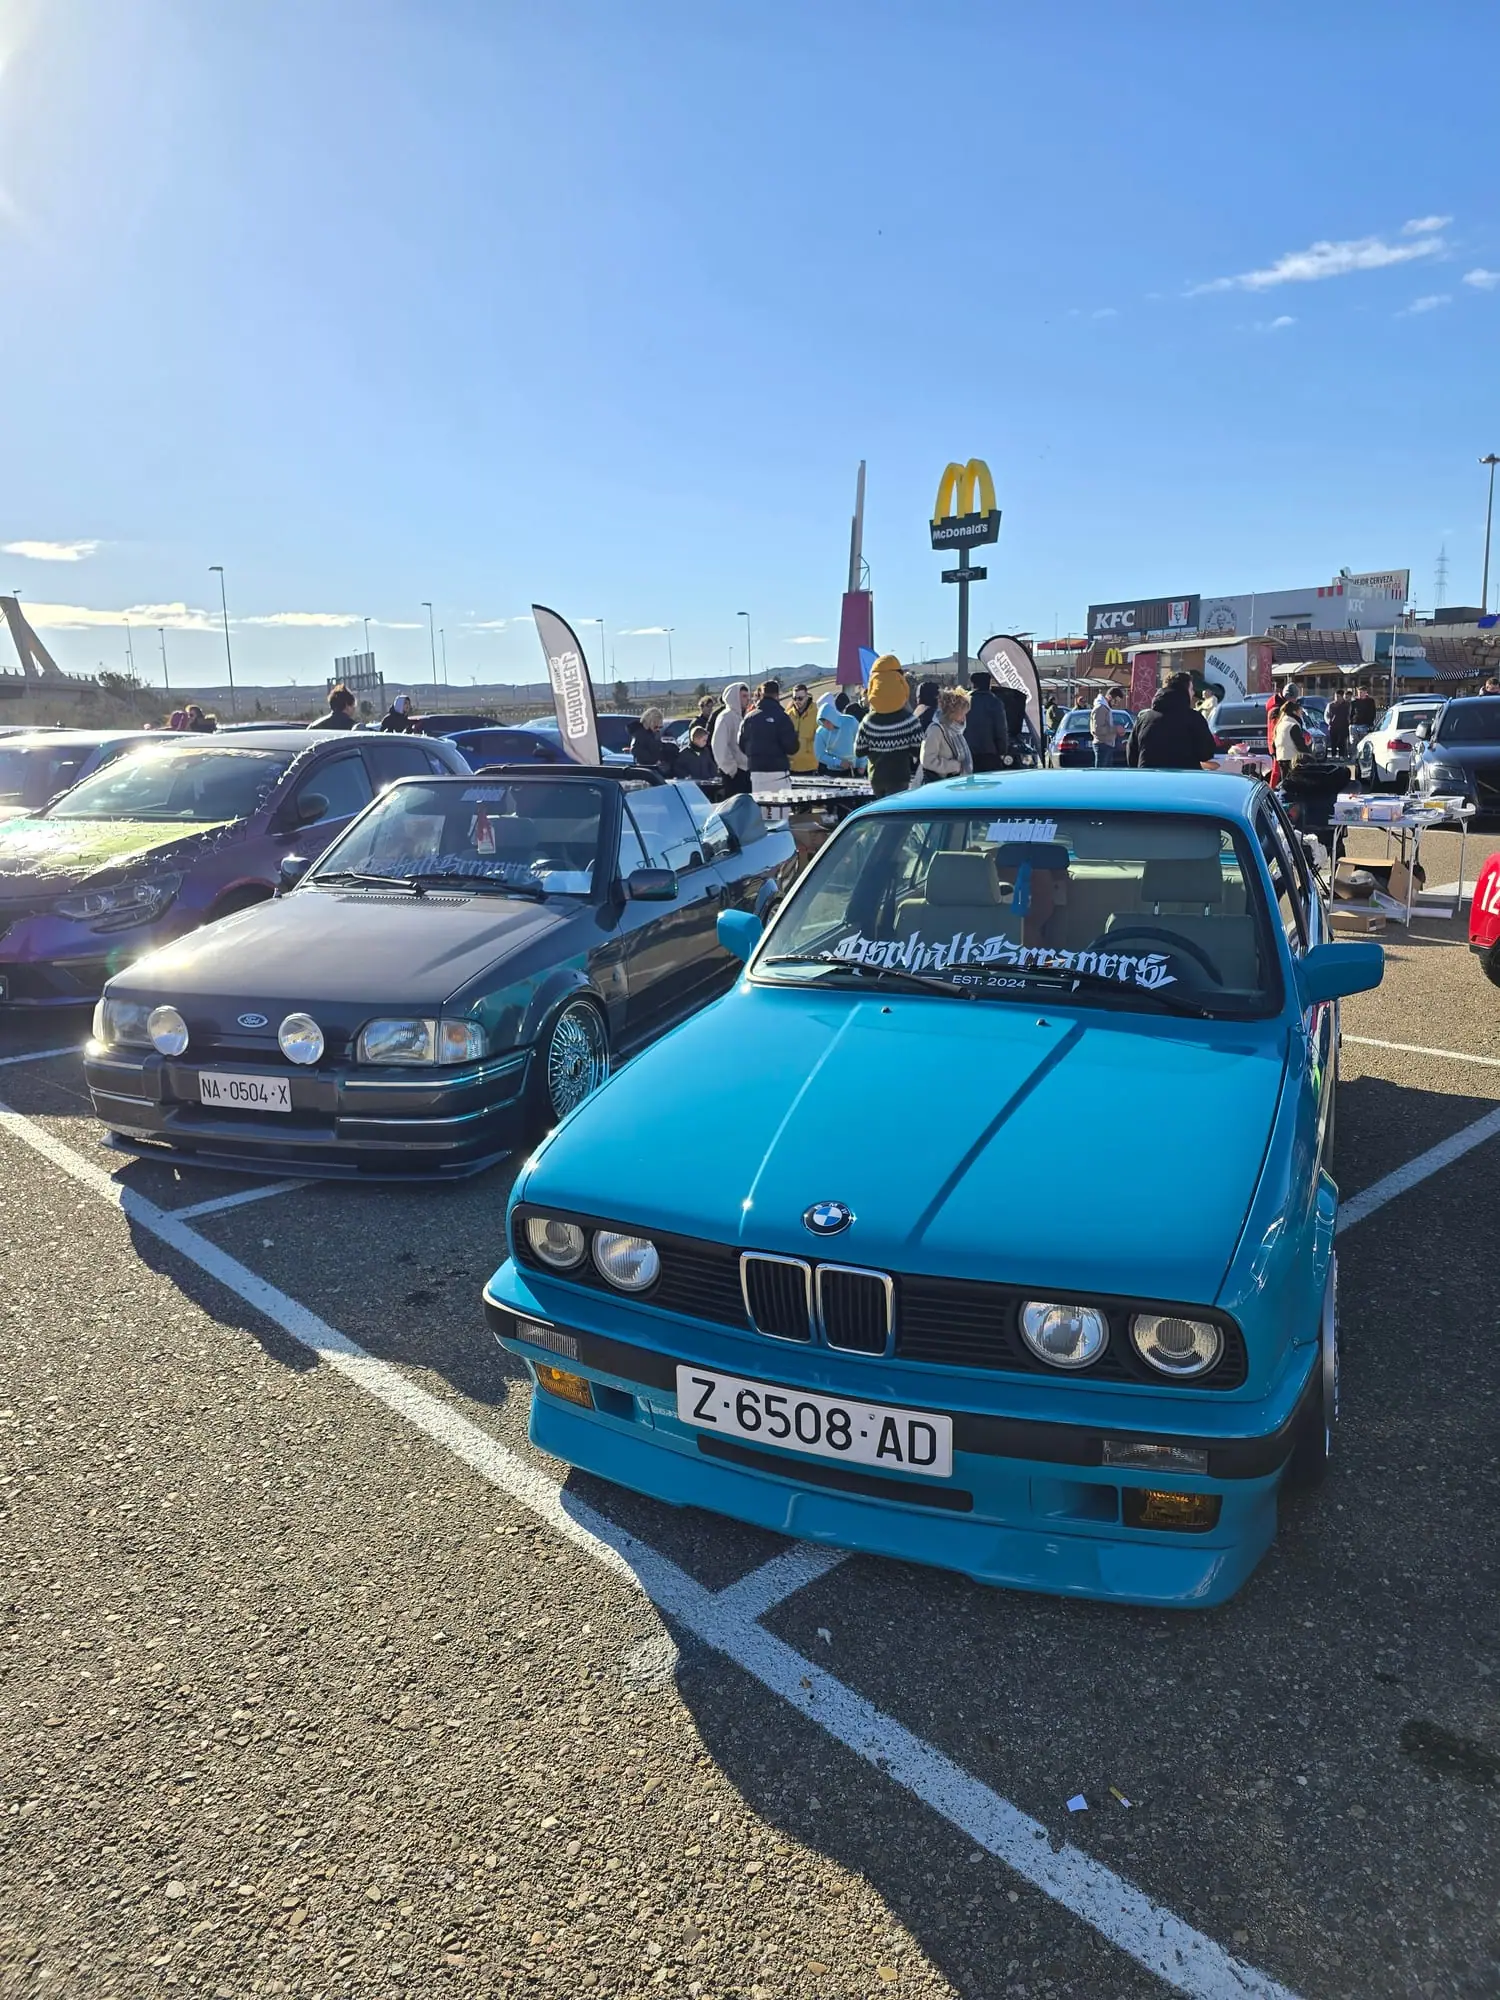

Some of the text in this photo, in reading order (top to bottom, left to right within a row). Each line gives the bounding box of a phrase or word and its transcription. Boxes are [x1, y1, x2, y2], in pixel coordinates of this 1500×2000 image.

[933, 523, 988, 540] McDonald's
[1370, 575, 1393, 585] CERVEZA
[1094, 609, 1136, 630] KFC
[1207, 655, 1231, 675] RONALD
[952, 975, 1026, 988] EST. 2024
